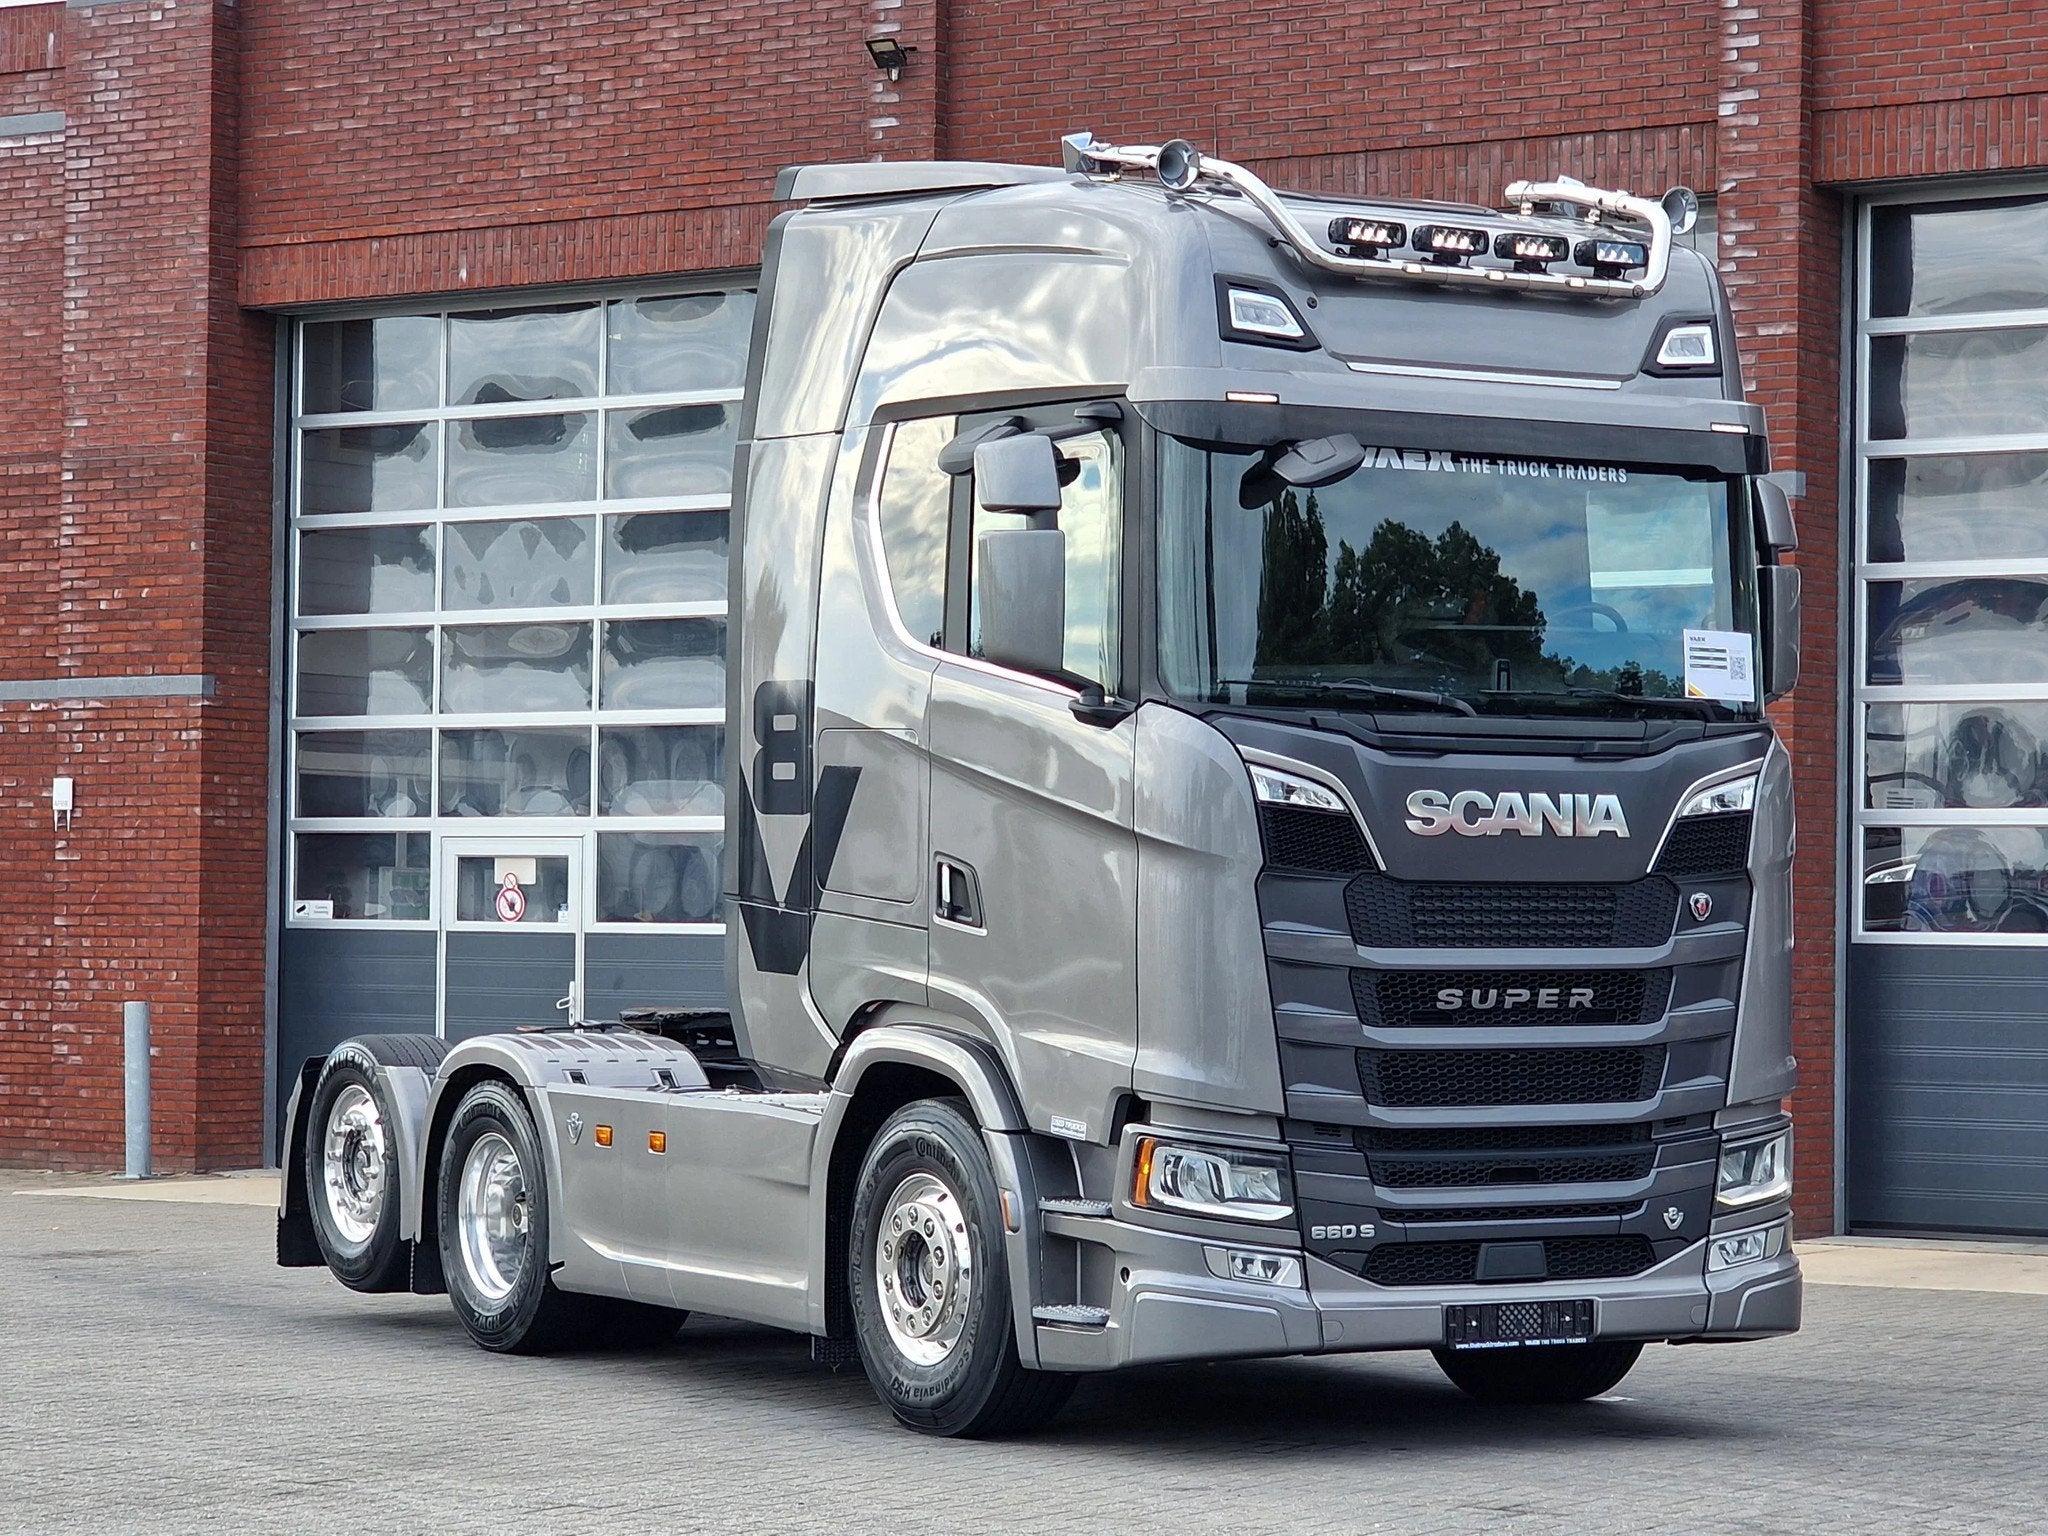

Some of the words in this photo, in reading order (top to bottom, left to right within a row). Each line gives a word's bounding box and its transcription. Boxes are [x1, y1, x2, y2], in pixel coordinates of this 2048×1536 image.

[1460, 457, 1490, 475] THE
[1497, 459, 1550, 478] TRUCK
[1555, 463, 1628, 483] TRADERS
[1404, 789, 1631, 838] SCANIA
[1435, 988, 1594, 1010] SUPER
[1311, 1225, 1356, 1240] 660
[1360, 1224, 1375, 1238] S
